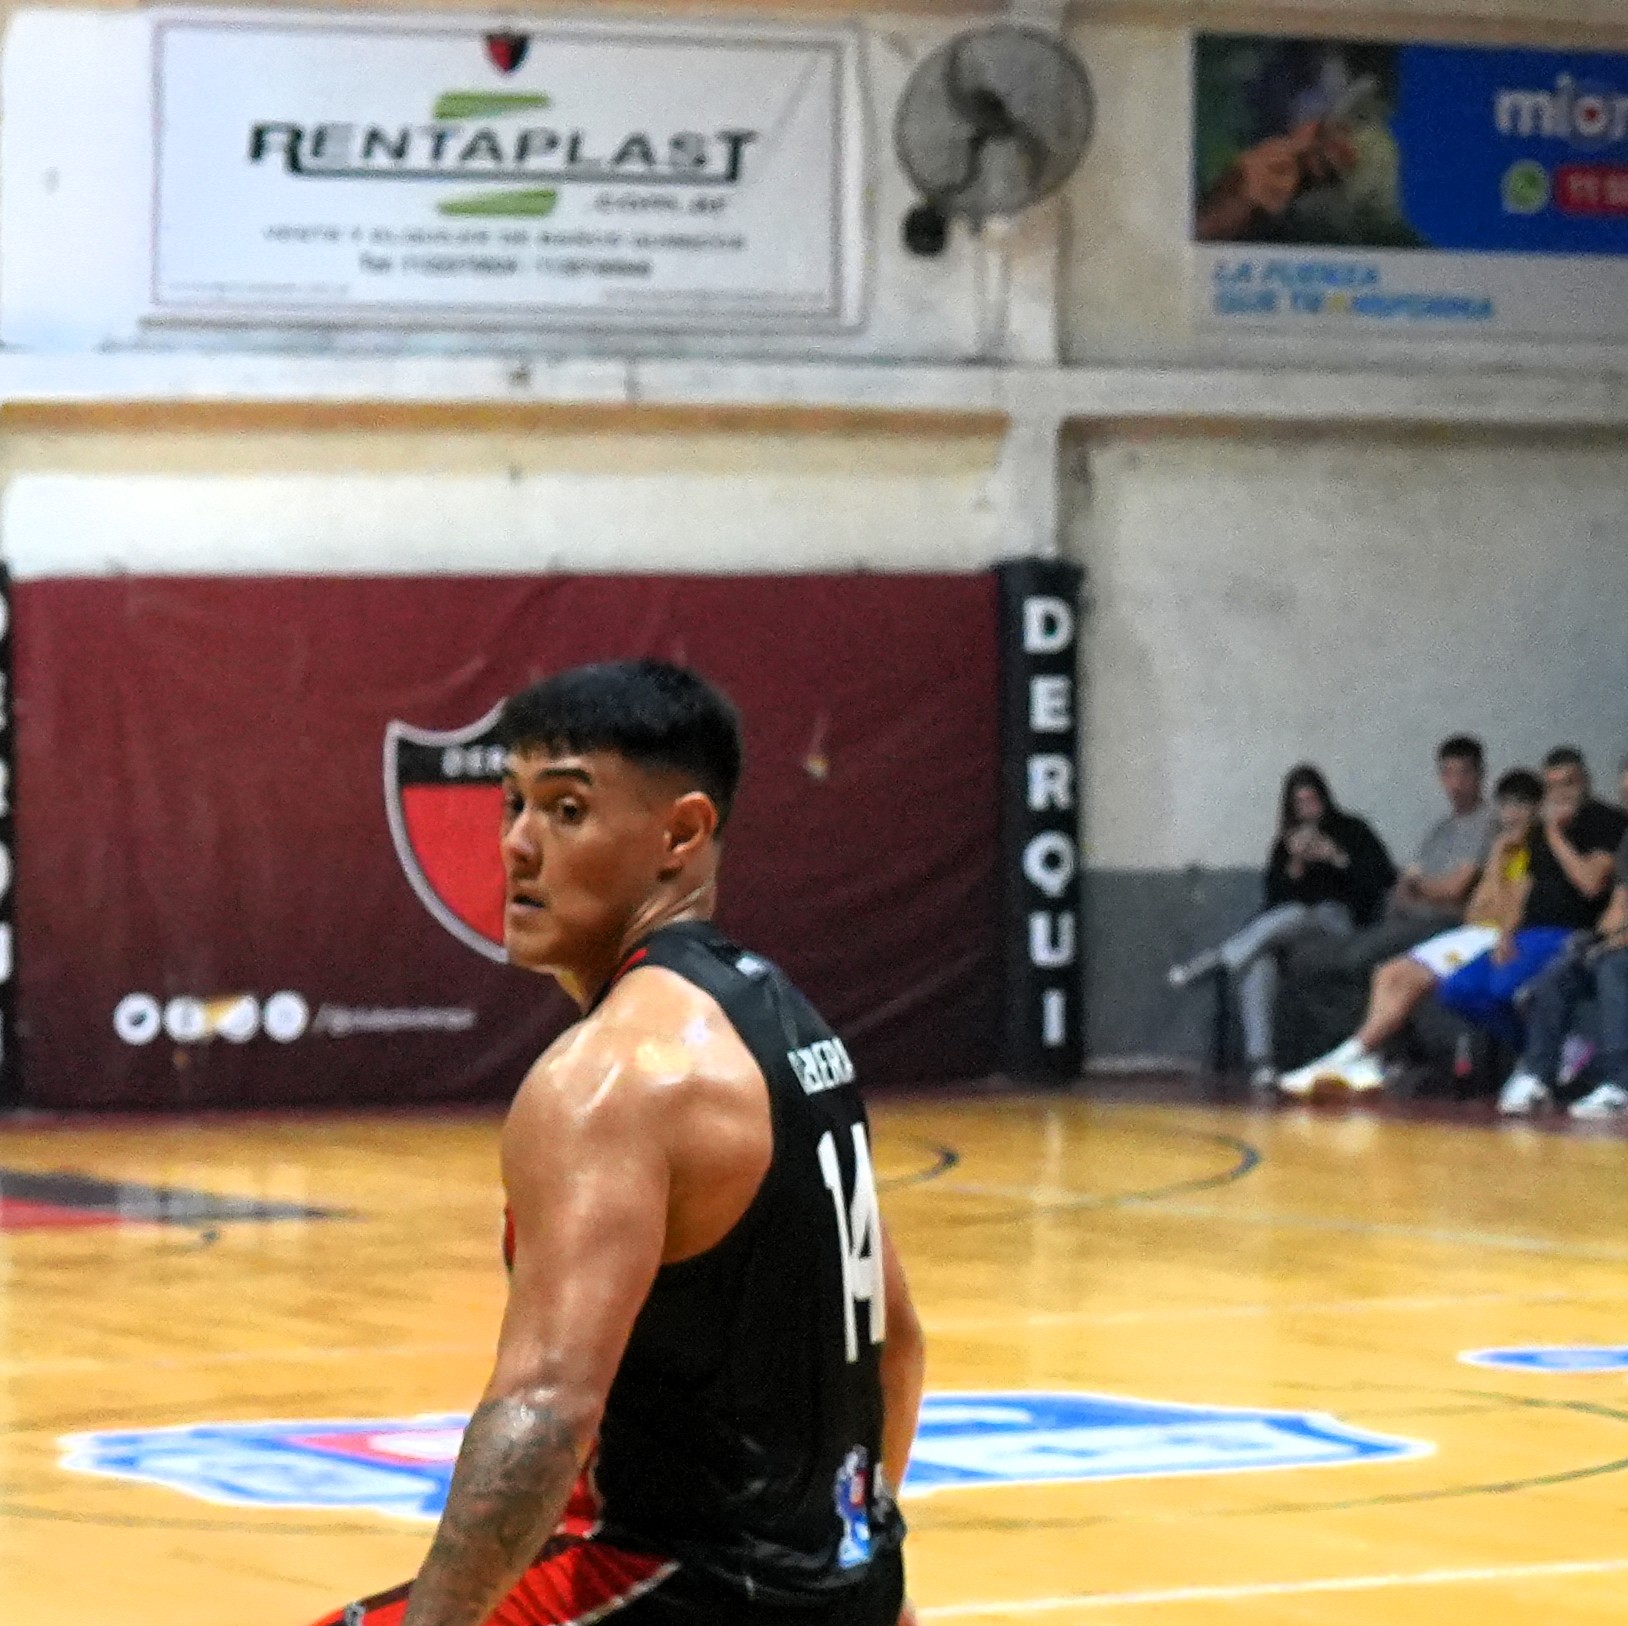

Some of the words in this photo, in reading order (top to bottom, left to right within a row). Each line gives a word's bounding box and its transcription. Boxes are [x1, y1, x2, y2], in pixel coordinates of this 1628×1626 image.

[248, 121, 758, 184] RENTAPLAST
[1023, 596, 1075, 1048] DERQUI
[817, 1121, 886, 1363] 14
